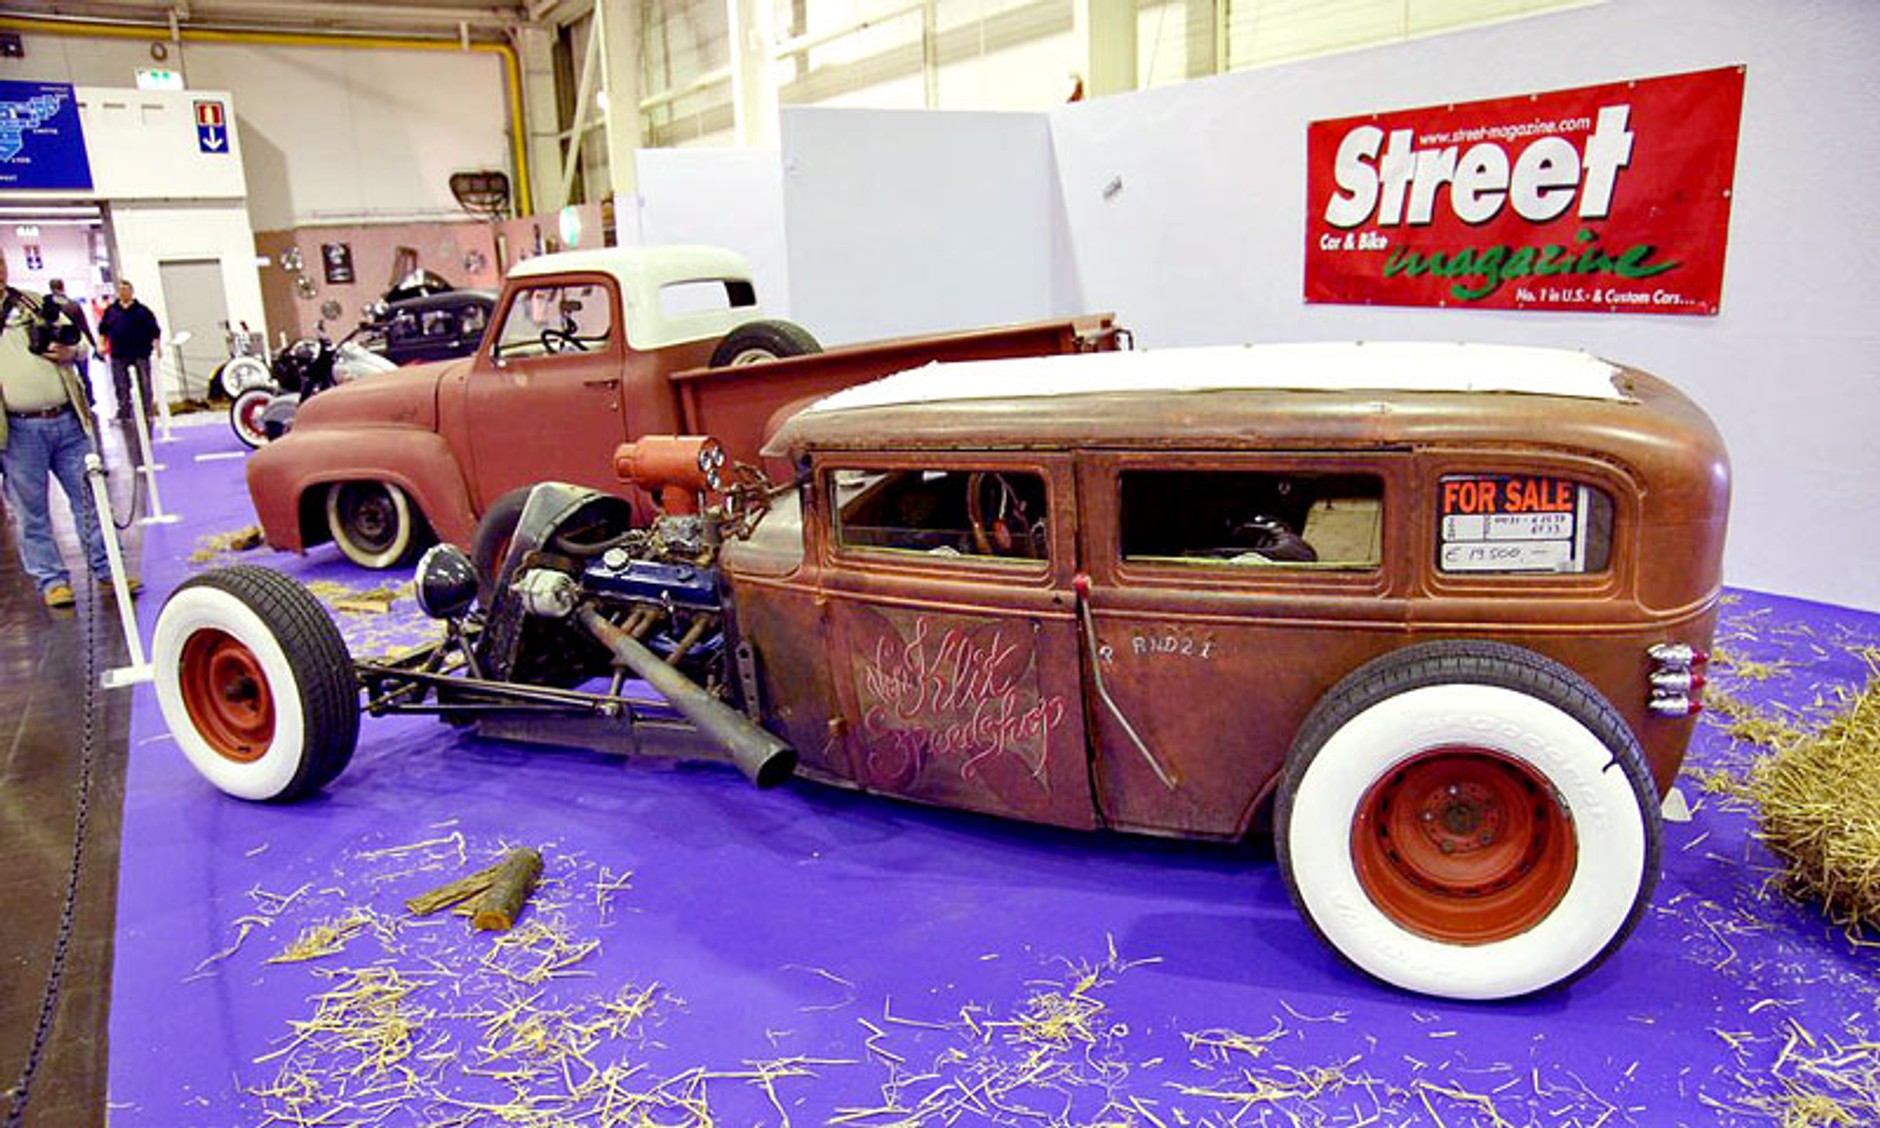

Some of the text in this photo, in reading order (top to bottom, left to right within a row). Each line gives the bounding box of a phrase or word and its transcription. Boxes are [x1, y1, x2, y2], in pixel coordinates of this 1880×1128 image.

[1419, 117, 1590, 145] www.street-magazine.com
[1324, 104, 1633, 228] Street
[1320, 229, 1388, 251] Car & Bike
[1383, 229, 1680, 300] magazine
[1516, 288, 1536, 302] No.
[1549, 287, 1560, 301] in
[1593, 289, 1602, 302] &
[1604, 288, 1650, 304] Custom
[1444, 479, 1573, 513] FOR SALE
